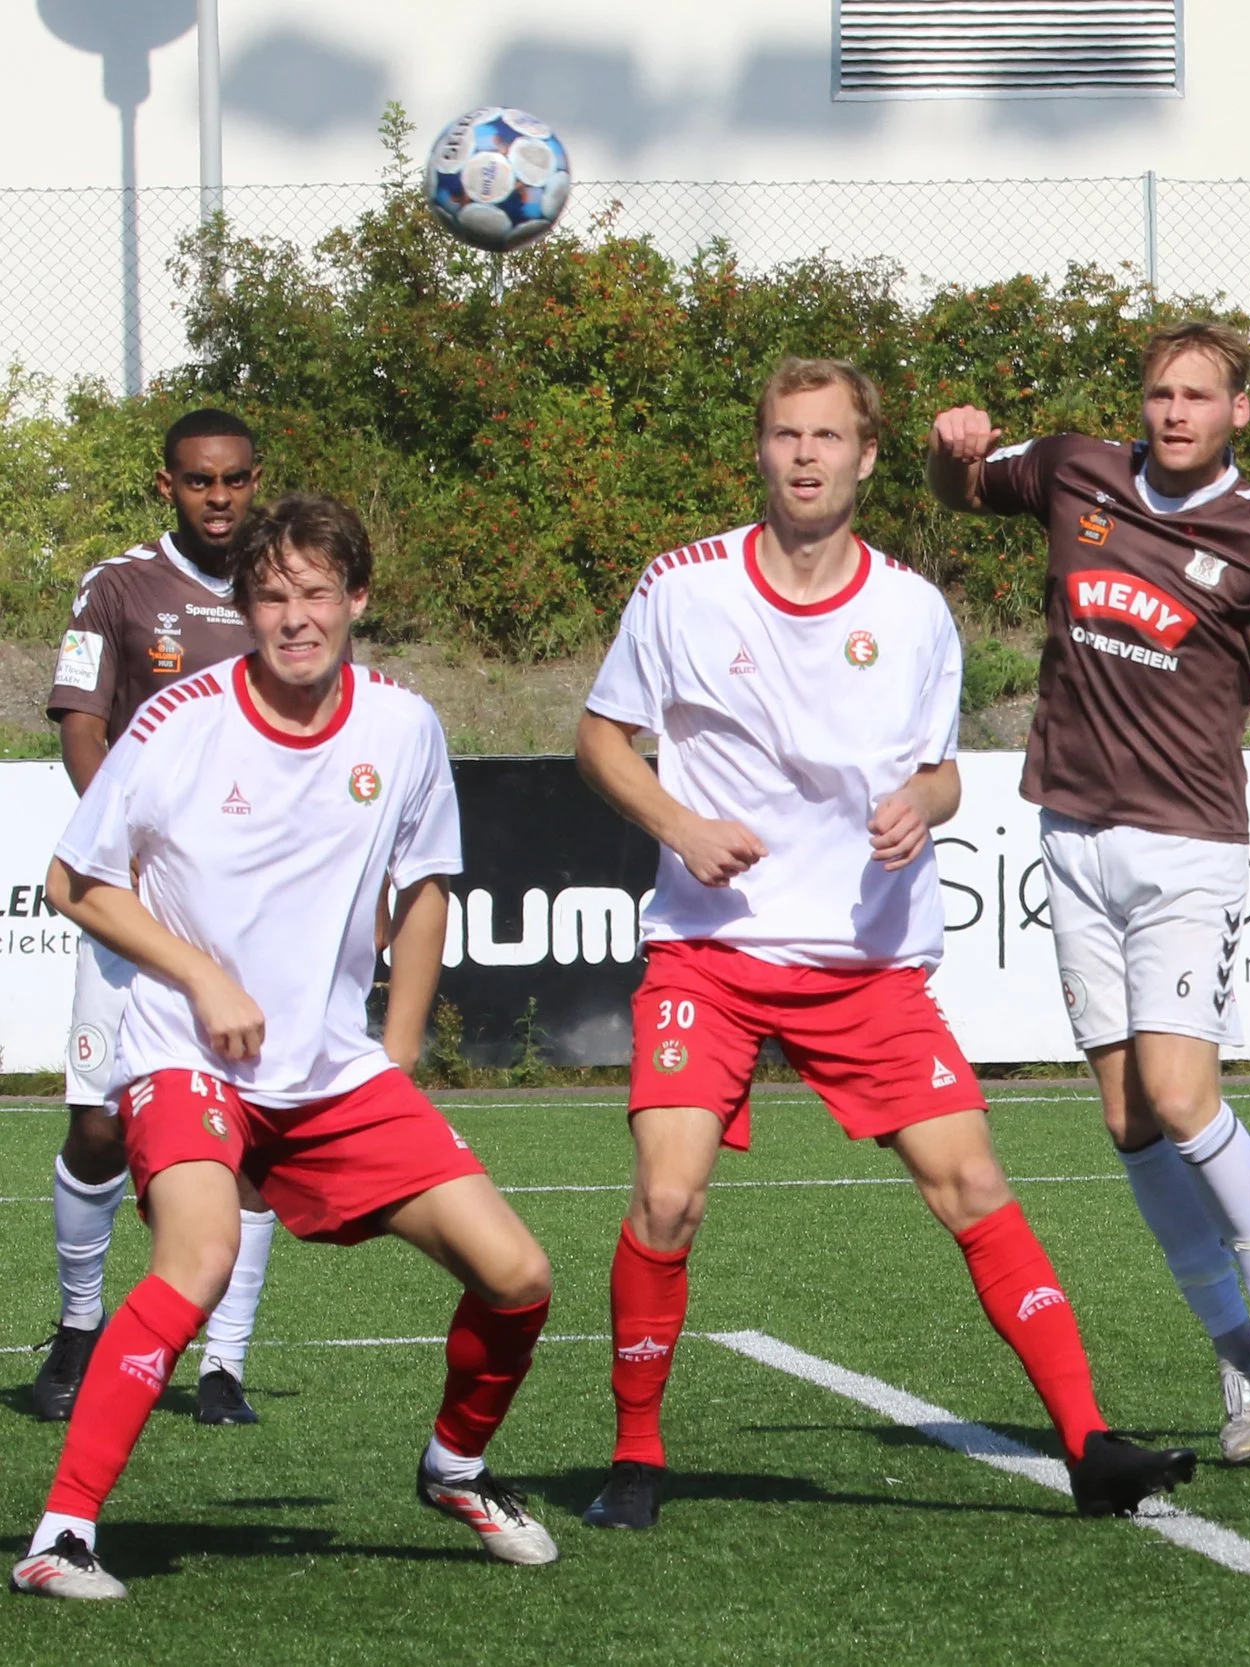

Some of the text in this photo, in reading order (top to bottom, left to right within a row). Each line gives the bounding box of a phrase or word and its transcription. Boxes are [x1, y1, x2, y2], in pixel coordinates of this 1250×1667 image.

[185, 603, 242, 619] SpareBan
[1078, 581, 1182, 632] MENY
[729, 666, 757, 676] SELECT
[221, 806, 252, 815] SELECT
[1176, 970, 1193, 998] 6
[656, 999, 696, 1030] 30
